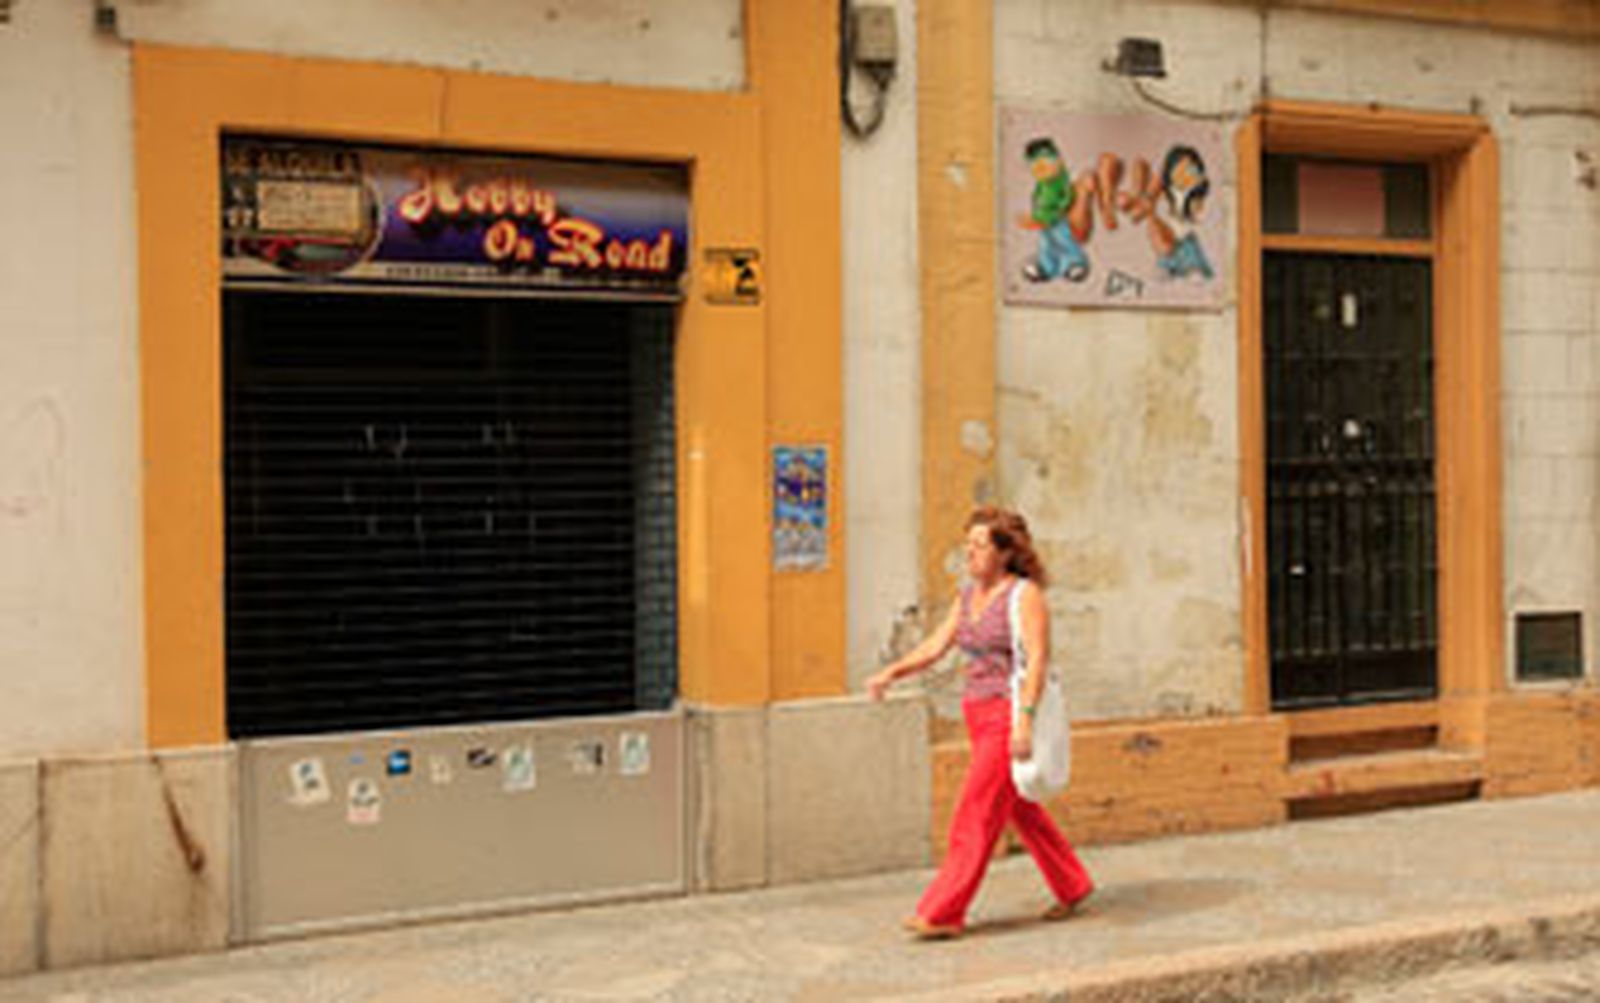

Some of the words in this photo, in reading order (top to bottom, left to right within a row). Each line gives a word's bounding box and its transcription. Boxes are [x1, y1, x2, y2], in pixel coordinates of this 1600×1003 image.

[399, 166, 558, 224] Hobby
[484, 221, 534, 261] On
[548, 219, 671, 271] Road
